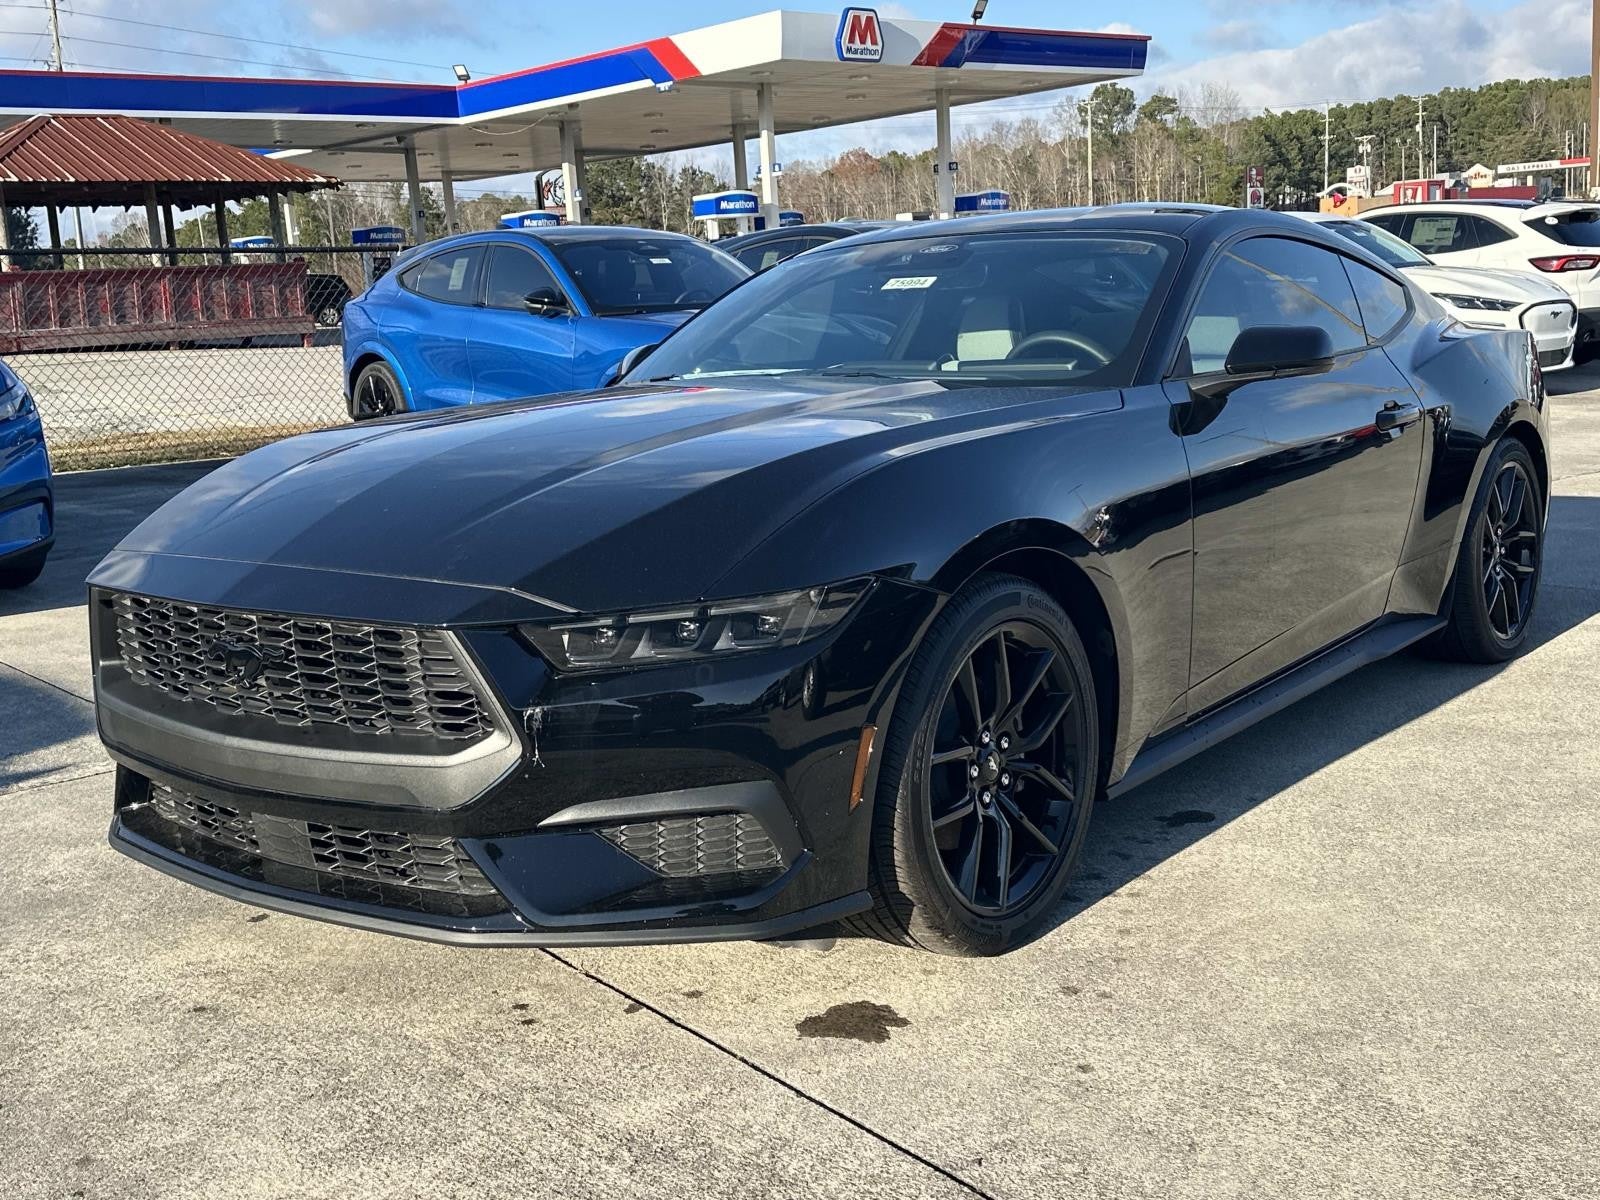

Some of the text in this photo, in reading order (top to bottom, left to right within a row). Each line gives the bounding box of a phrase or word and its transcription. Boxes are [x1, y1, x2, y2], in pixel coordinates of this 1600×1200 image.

[847, 14, 879, 46] M
[845, 46, 880, 56] Marathon
[720, 200, 755, 210] Marathon
[980, 198, 1007, 206] Marathon
[523, 218, 557, 227] Marathon
[369, 231, 402, 240] Marathon
